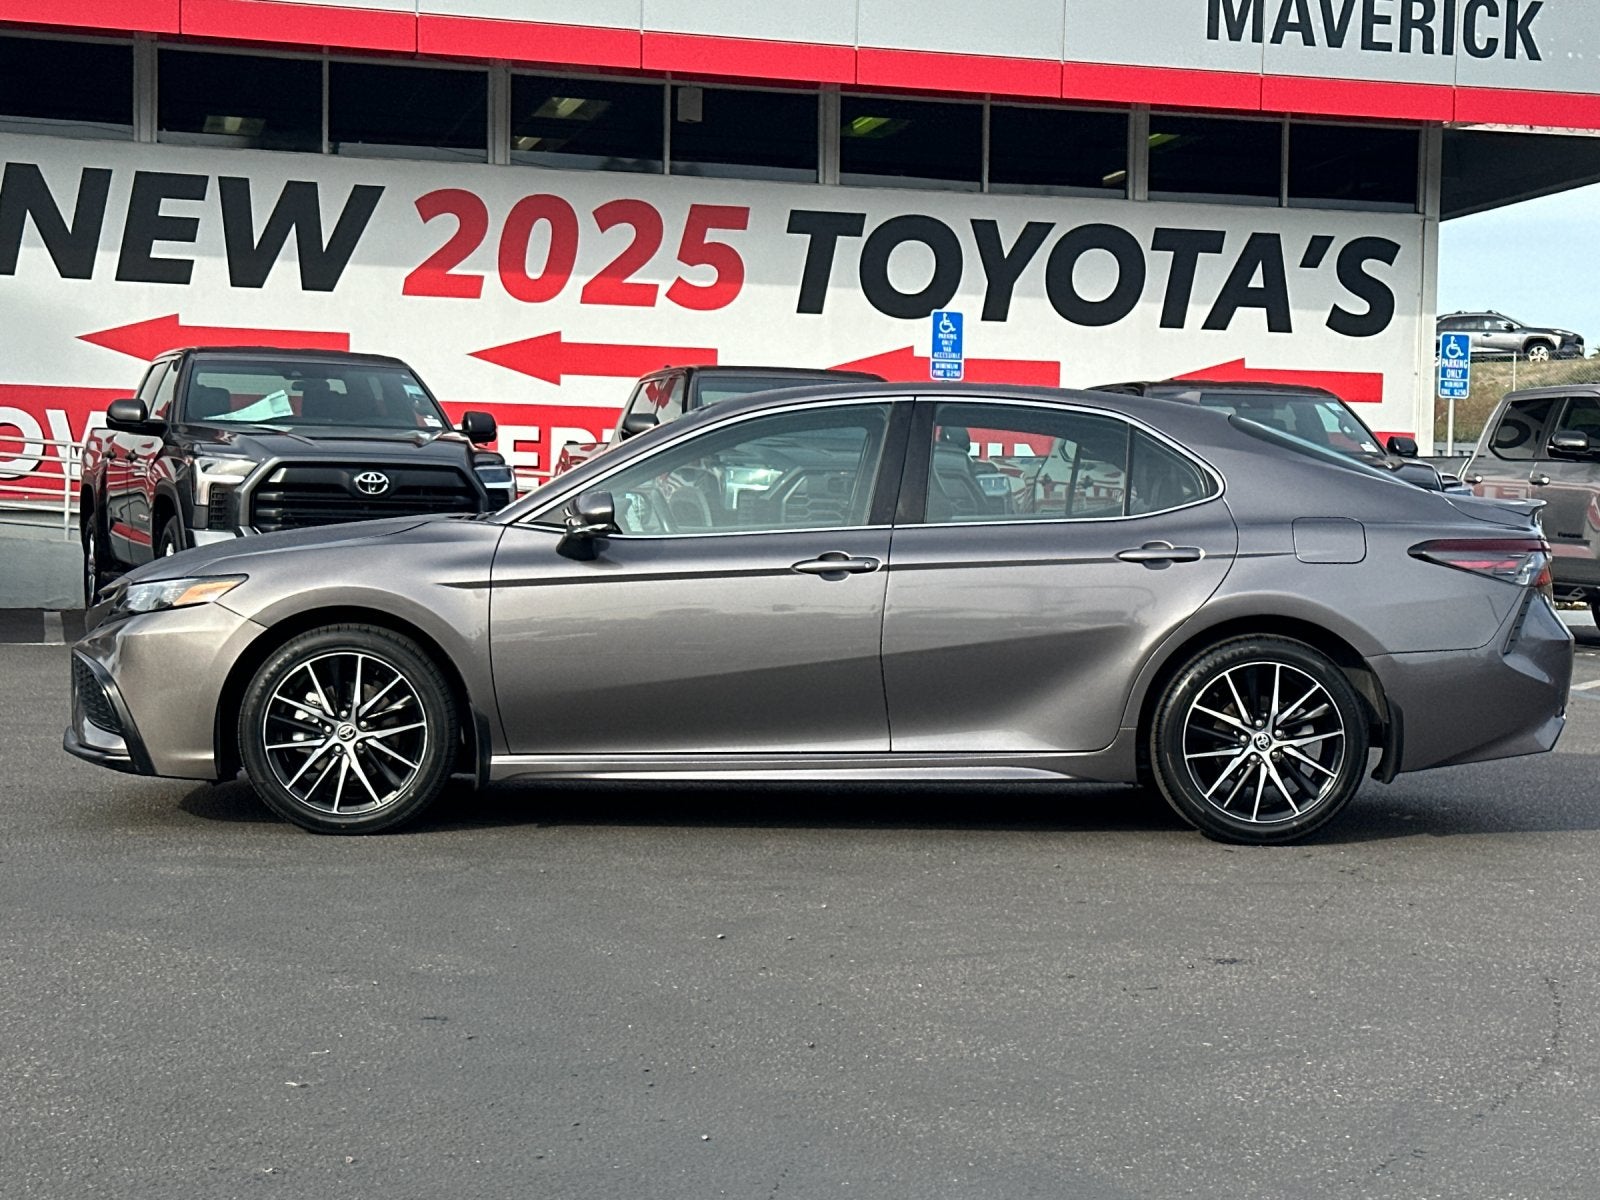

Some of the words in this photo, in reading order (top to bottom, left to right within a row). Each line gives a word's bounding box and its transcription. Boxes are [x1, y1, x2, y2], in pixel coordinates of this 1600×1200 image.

[1206, 0, 1543, 62] MAVERICK
[0, 161, 386, 292] NEW
[402, 188, 750, 311] 2025
[786, 209, 1402, 338] TOYOTA'S
[1441, 359, 1468, 369] PARKING
[1446, 369, 1463, 378] ONLY
